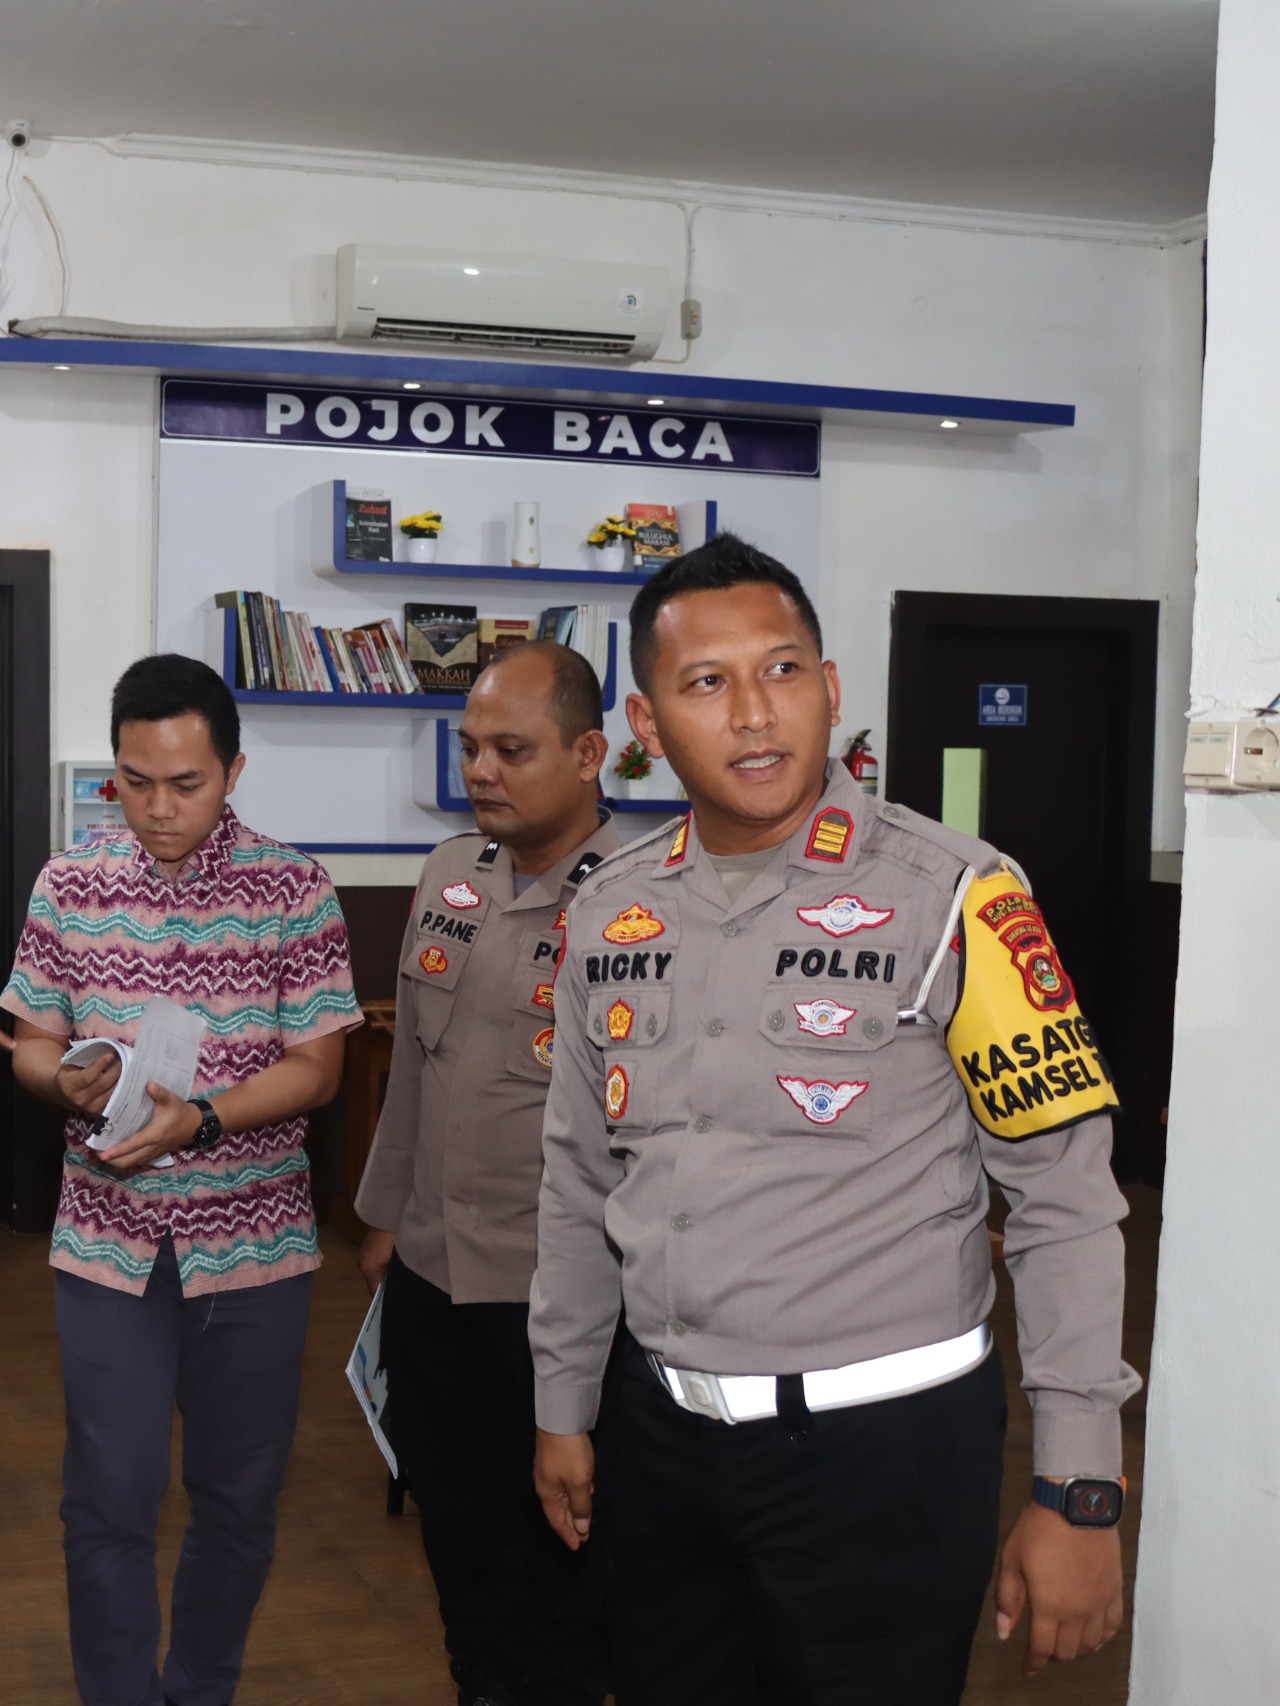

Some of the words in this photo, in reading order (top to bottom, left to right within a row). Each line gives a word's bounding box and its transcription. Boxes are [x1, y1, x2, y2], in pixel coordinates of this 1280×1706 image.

[266, 393, 505, 448] POJOK
[554, 410, 734, 463] BACA
[417, 667, 470, 681] MAKKAH
[420, 910, 478, 944] P.PANE
[586, 952, 672, 983] RICKY
[775, 948, 896, 983] POLRI
